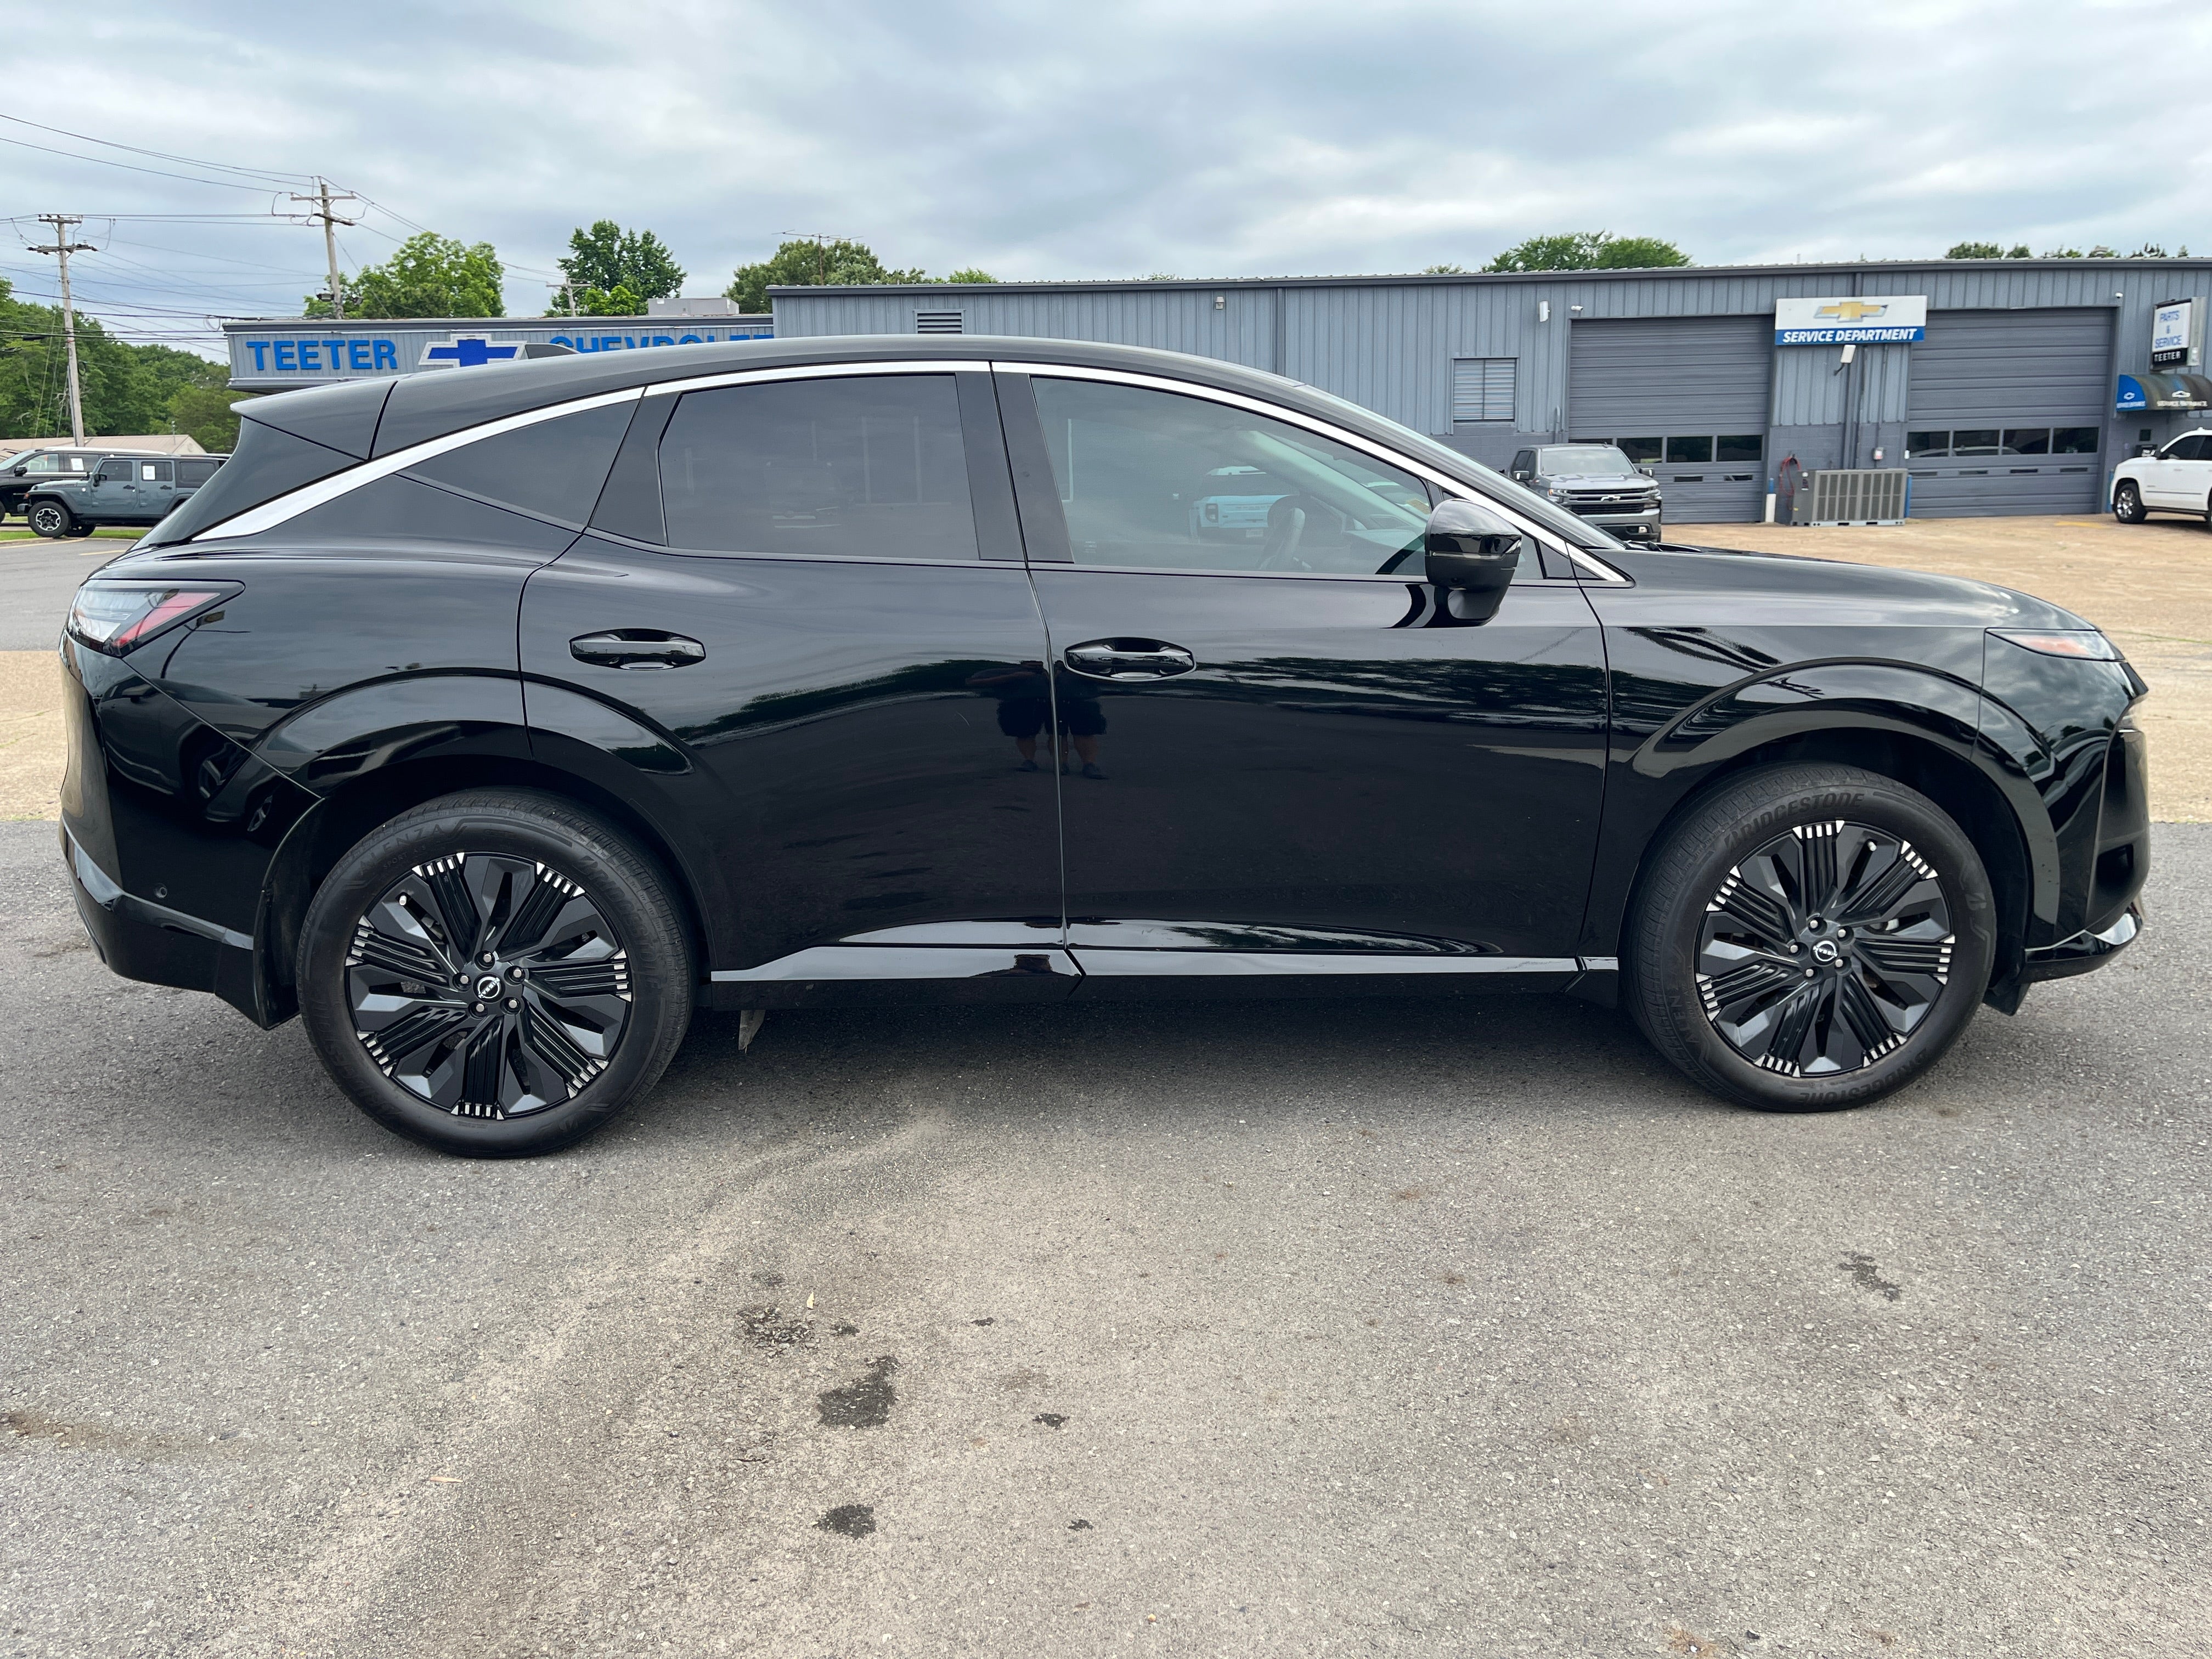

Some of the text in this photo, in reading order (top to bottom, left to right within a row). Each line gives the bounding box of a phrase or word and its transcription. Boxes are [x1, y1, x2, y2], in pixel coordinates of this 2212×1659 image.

[1782, 328, 1918, 343] SERVICE DEPARTMENT
[2155, 335, 2182, 348] SERVICE
[246, 340, 398, 370] TEETER
[2154, 351, 2181, 362] TEETER
[1724, 792, 1865, 851] BRIDGESTONE
[572, 854, 663, 990] BRIDGESTONE
[1813, 945, 1838, 957] NISSAN
[478, 977, 500, 998] NISSAN
[1798, 1046, 1929, 1105] BRIDGESTONE
